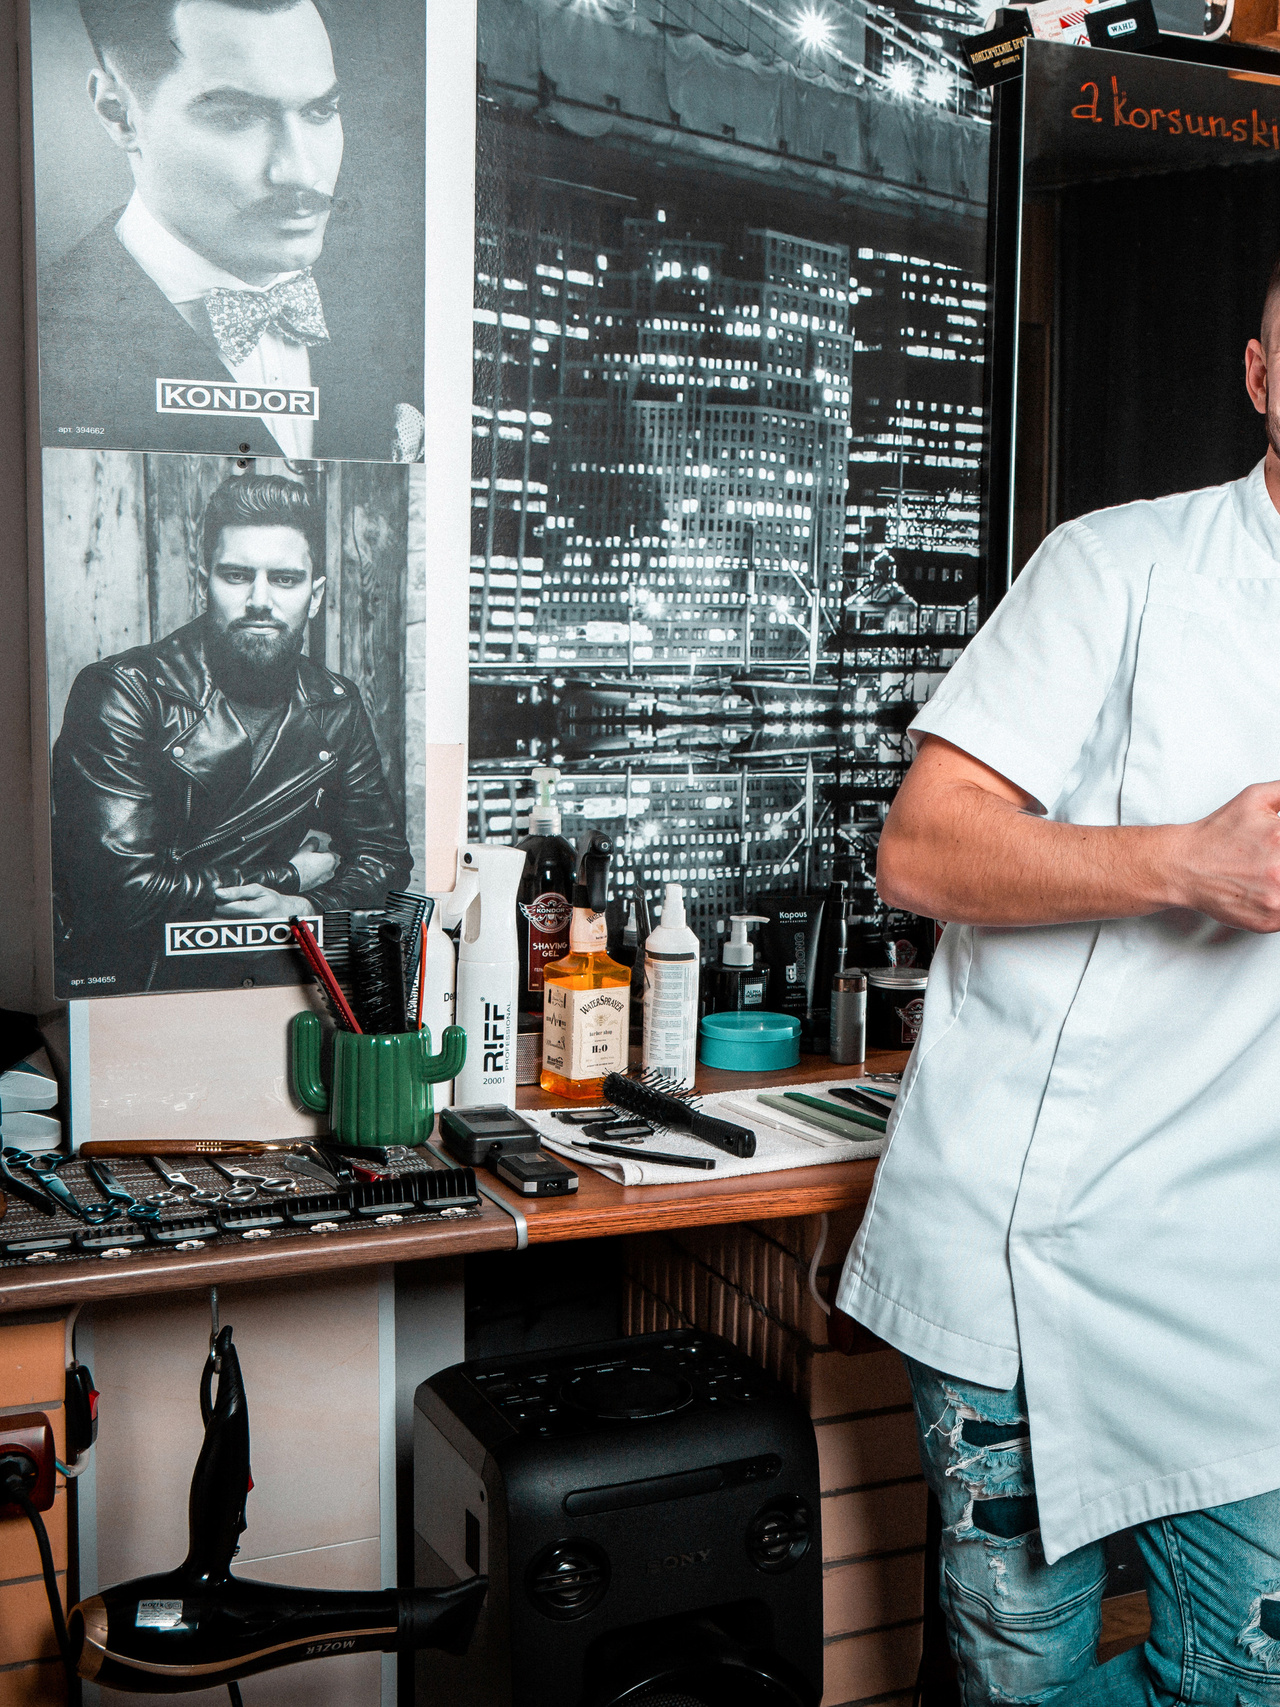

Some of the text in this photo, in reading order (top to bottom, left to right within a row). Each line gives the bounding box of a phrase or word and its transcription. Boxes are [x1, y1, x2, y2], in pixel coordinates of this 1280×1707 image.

[1111, 21, 1134, 32] WAHL
[164, 385, 312, 414] KONDOR
[75, 426, 105, 435] 394662
[779, 911, 808, 921] Kapous
[532, 941, 568, 951] SHAVING
[541, 950, 560, 958] GEL
[794, 931, 806, 983] STRONG
[87, 975, 116, 984] 394655
[483, 1077, 505, 1085] 20001
[306, 1639, 356, 1655] MOZER
